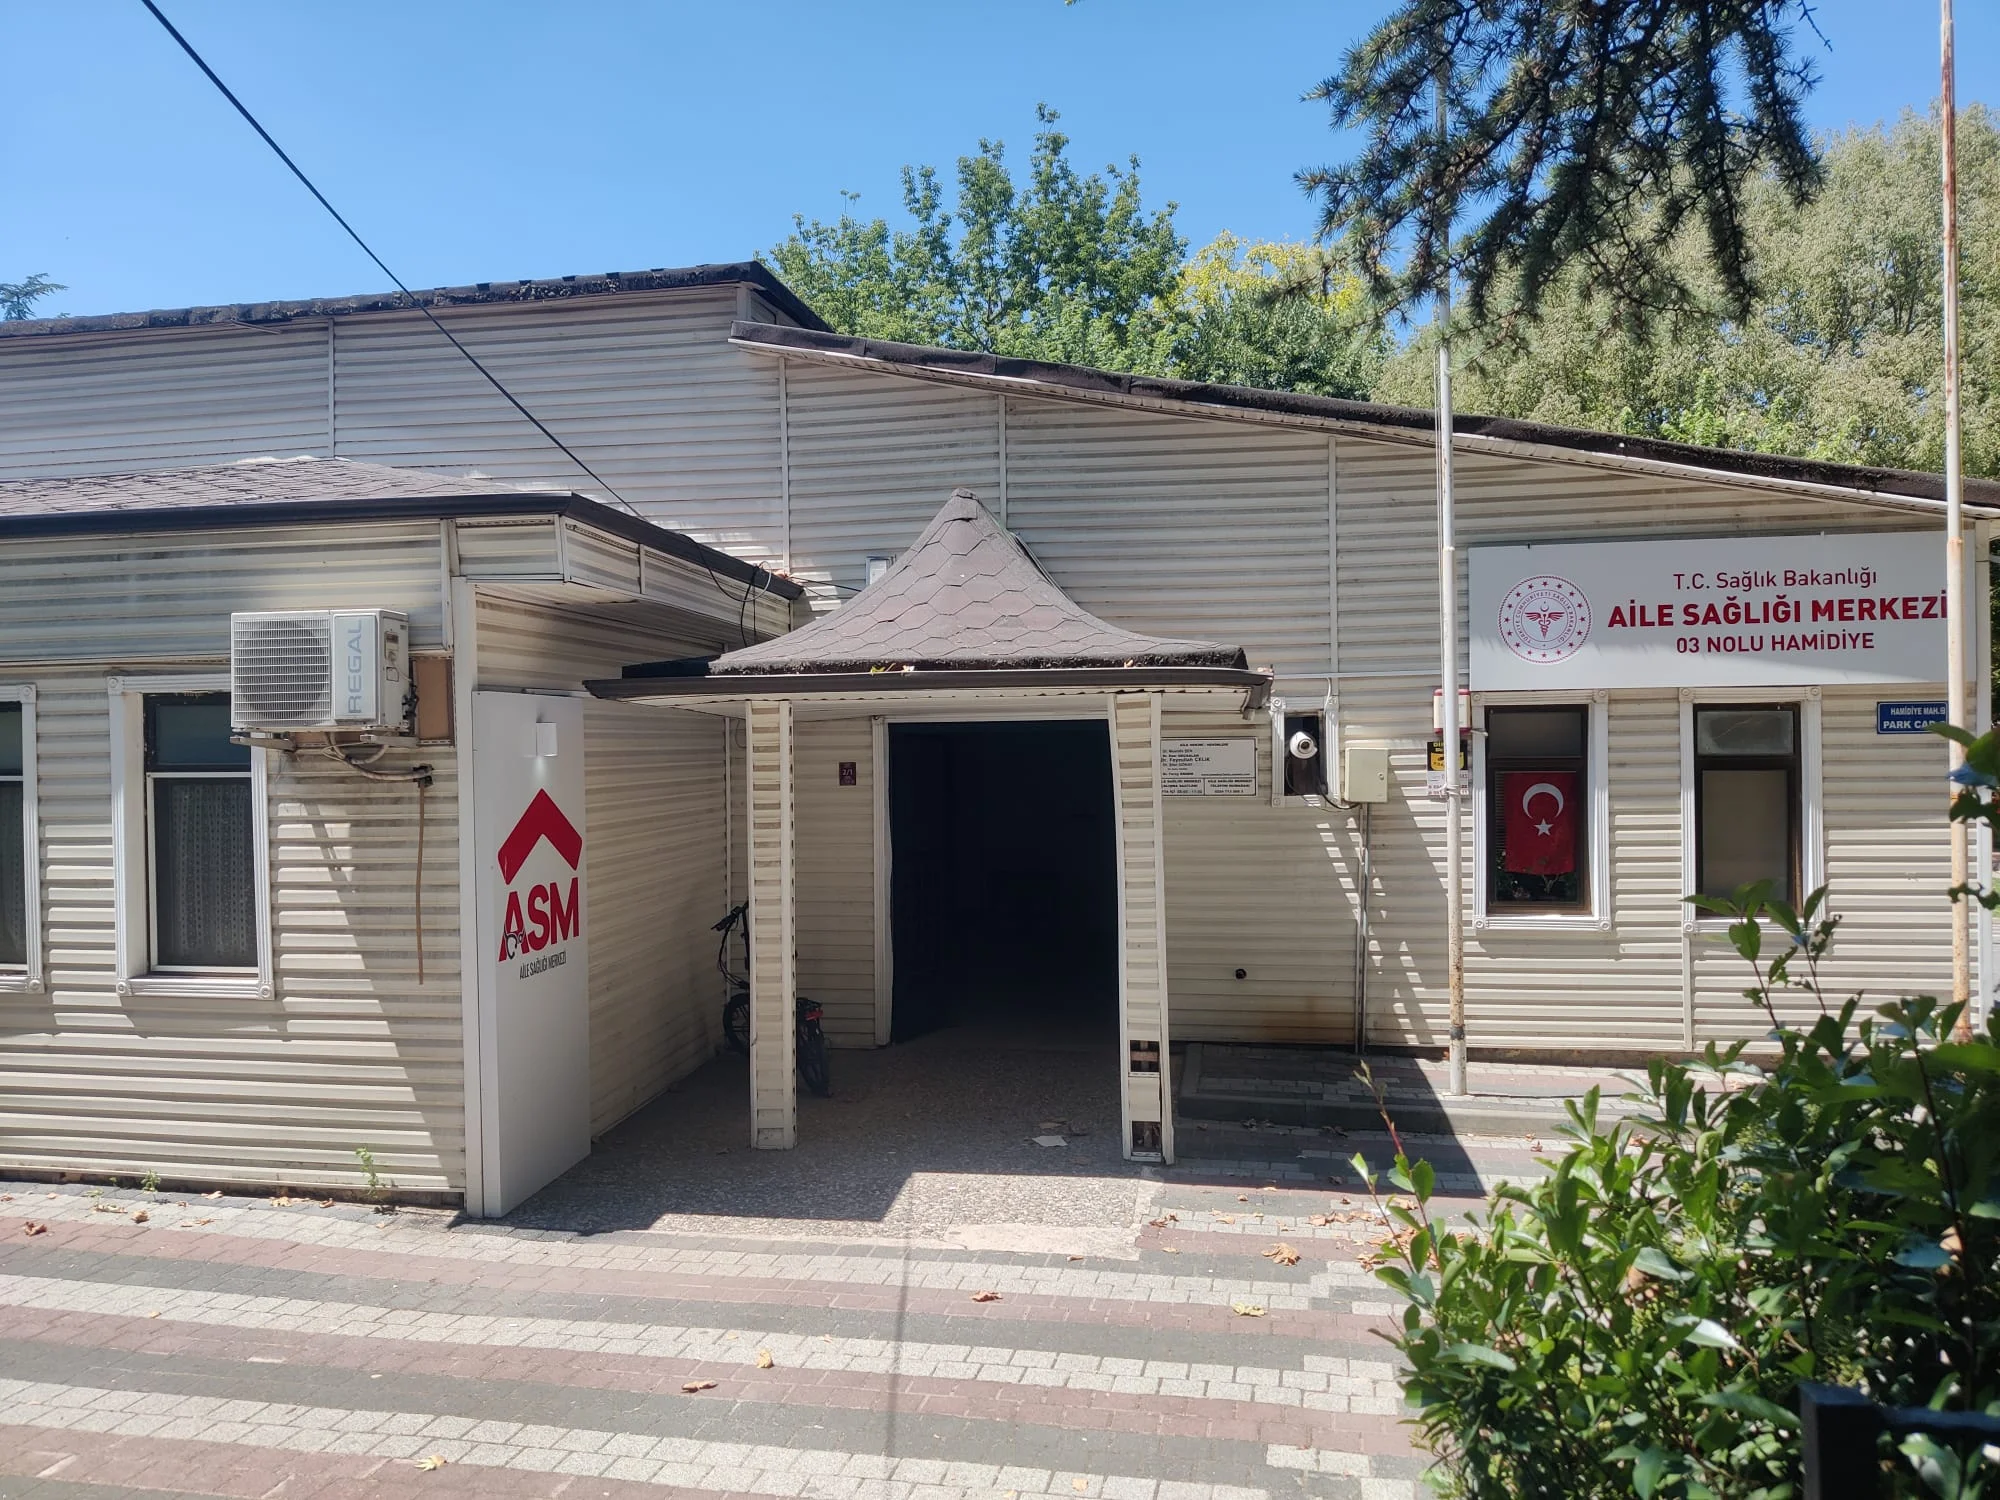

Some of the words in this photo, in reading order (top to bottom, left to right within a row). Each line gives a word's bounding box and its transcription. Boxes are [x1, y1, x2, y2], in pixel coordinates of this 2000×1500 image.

[1673, 573, 1711, 590] T.C.
[1716, 570, 1777, 592] Sağlık
[1784, 567, 1877, 588] Bakanlığı
[1608, 599, 1675, 629] AİLE
[1682, 594, 1802, 627] SAĞLIĞI
[1811, 590, 1947, 623] MERKEZİ
[1676, 637, 1700, 654] 03
[1707, 635, 1764, 653] NOLU
[1771, 629, 1875, 652] HAMİDİYE
[348, 619, 362, 714] REGAL
[1890, 705, 1922, 716] HAMİDİYE
[1883, 720, 1912, 729] PARK
[499, 877, 579, 962] ASM
[519, 962, 530, 980] AİLE
[529, 955, 548, 976] SAĞLIĞI
